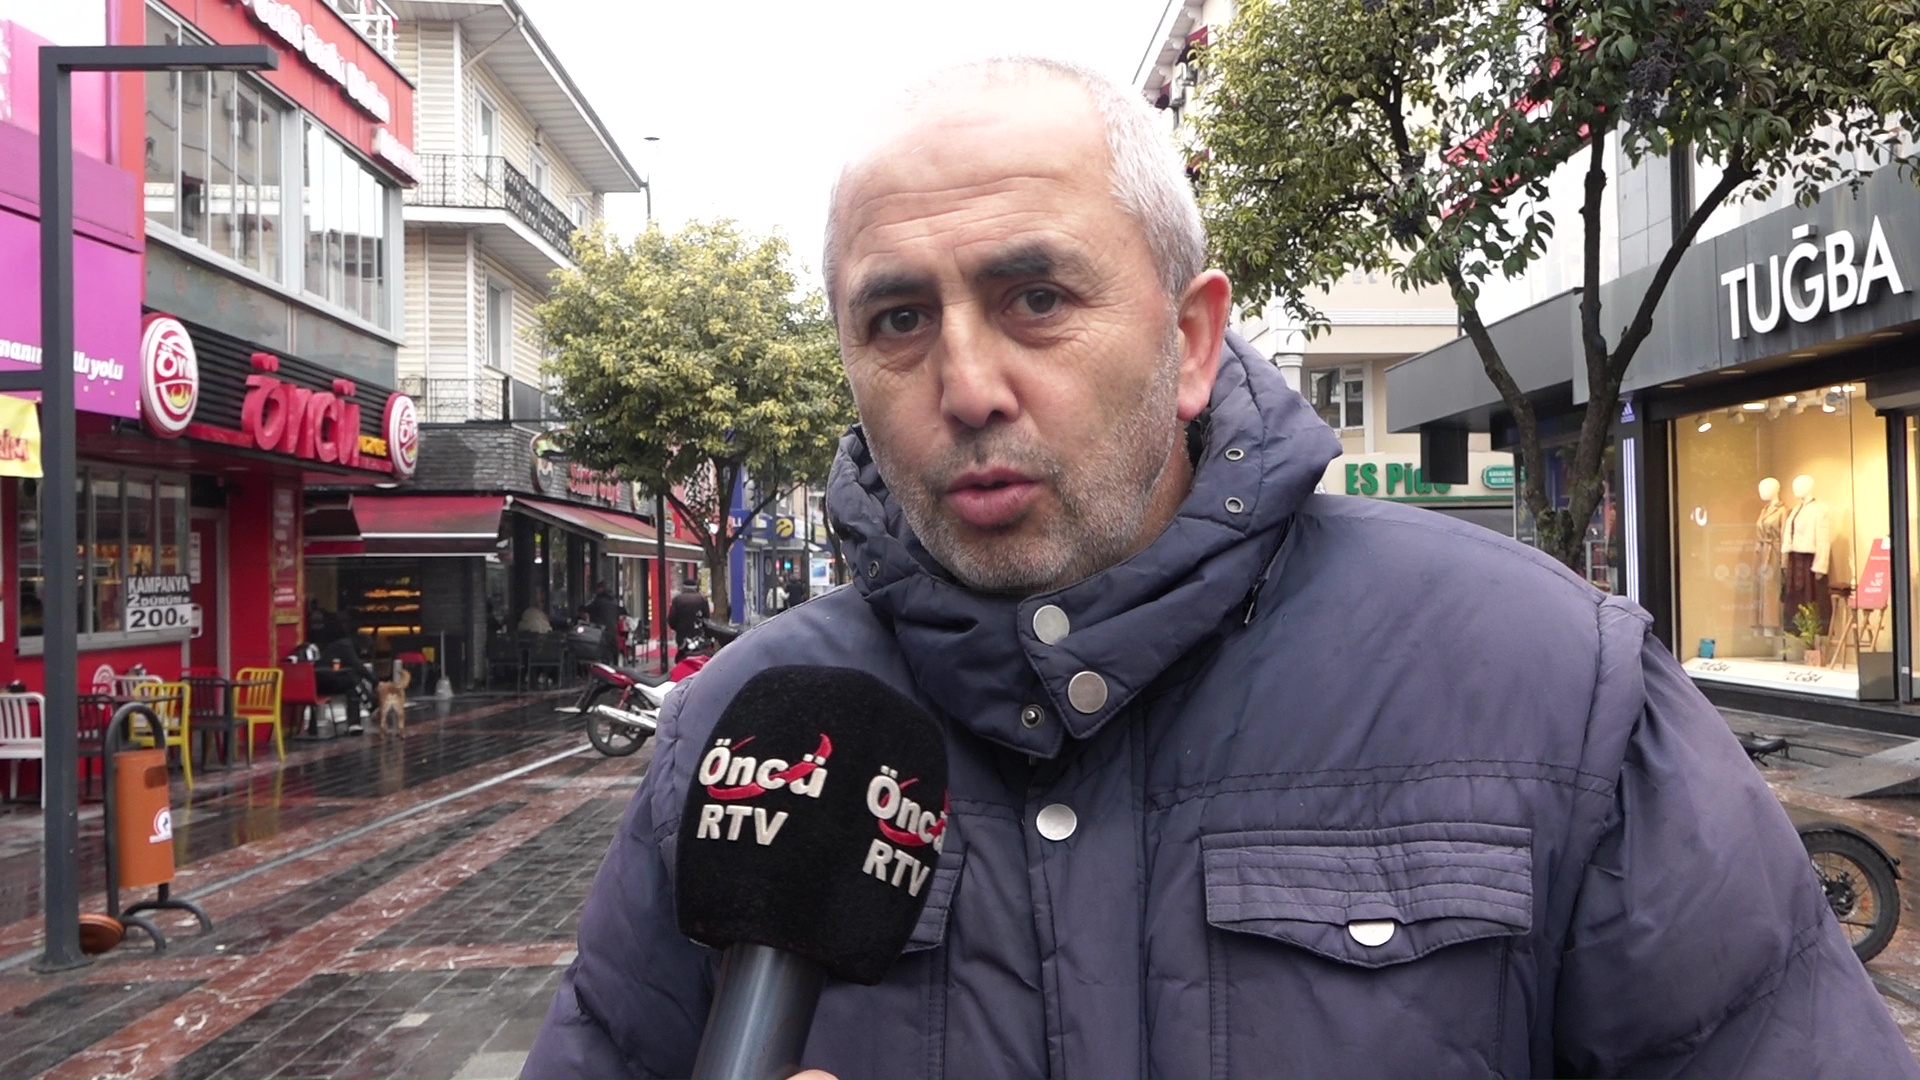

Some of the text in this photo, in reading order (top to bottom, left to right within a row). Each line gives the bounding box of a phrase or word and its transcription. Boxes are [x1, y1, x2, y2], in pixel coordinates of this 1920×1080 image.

[1720, 214, 1906, 341] TUĞBA
[87, 357, 124, 381] yolu
[1345, 462, 1379, 495] ES
[128, 576, 190, 593] KAMPANYA
[698, 737, 828, 799] Öncü
[696, 803, 789, 846] RTV
[862, 838, 932, 898] RTV
